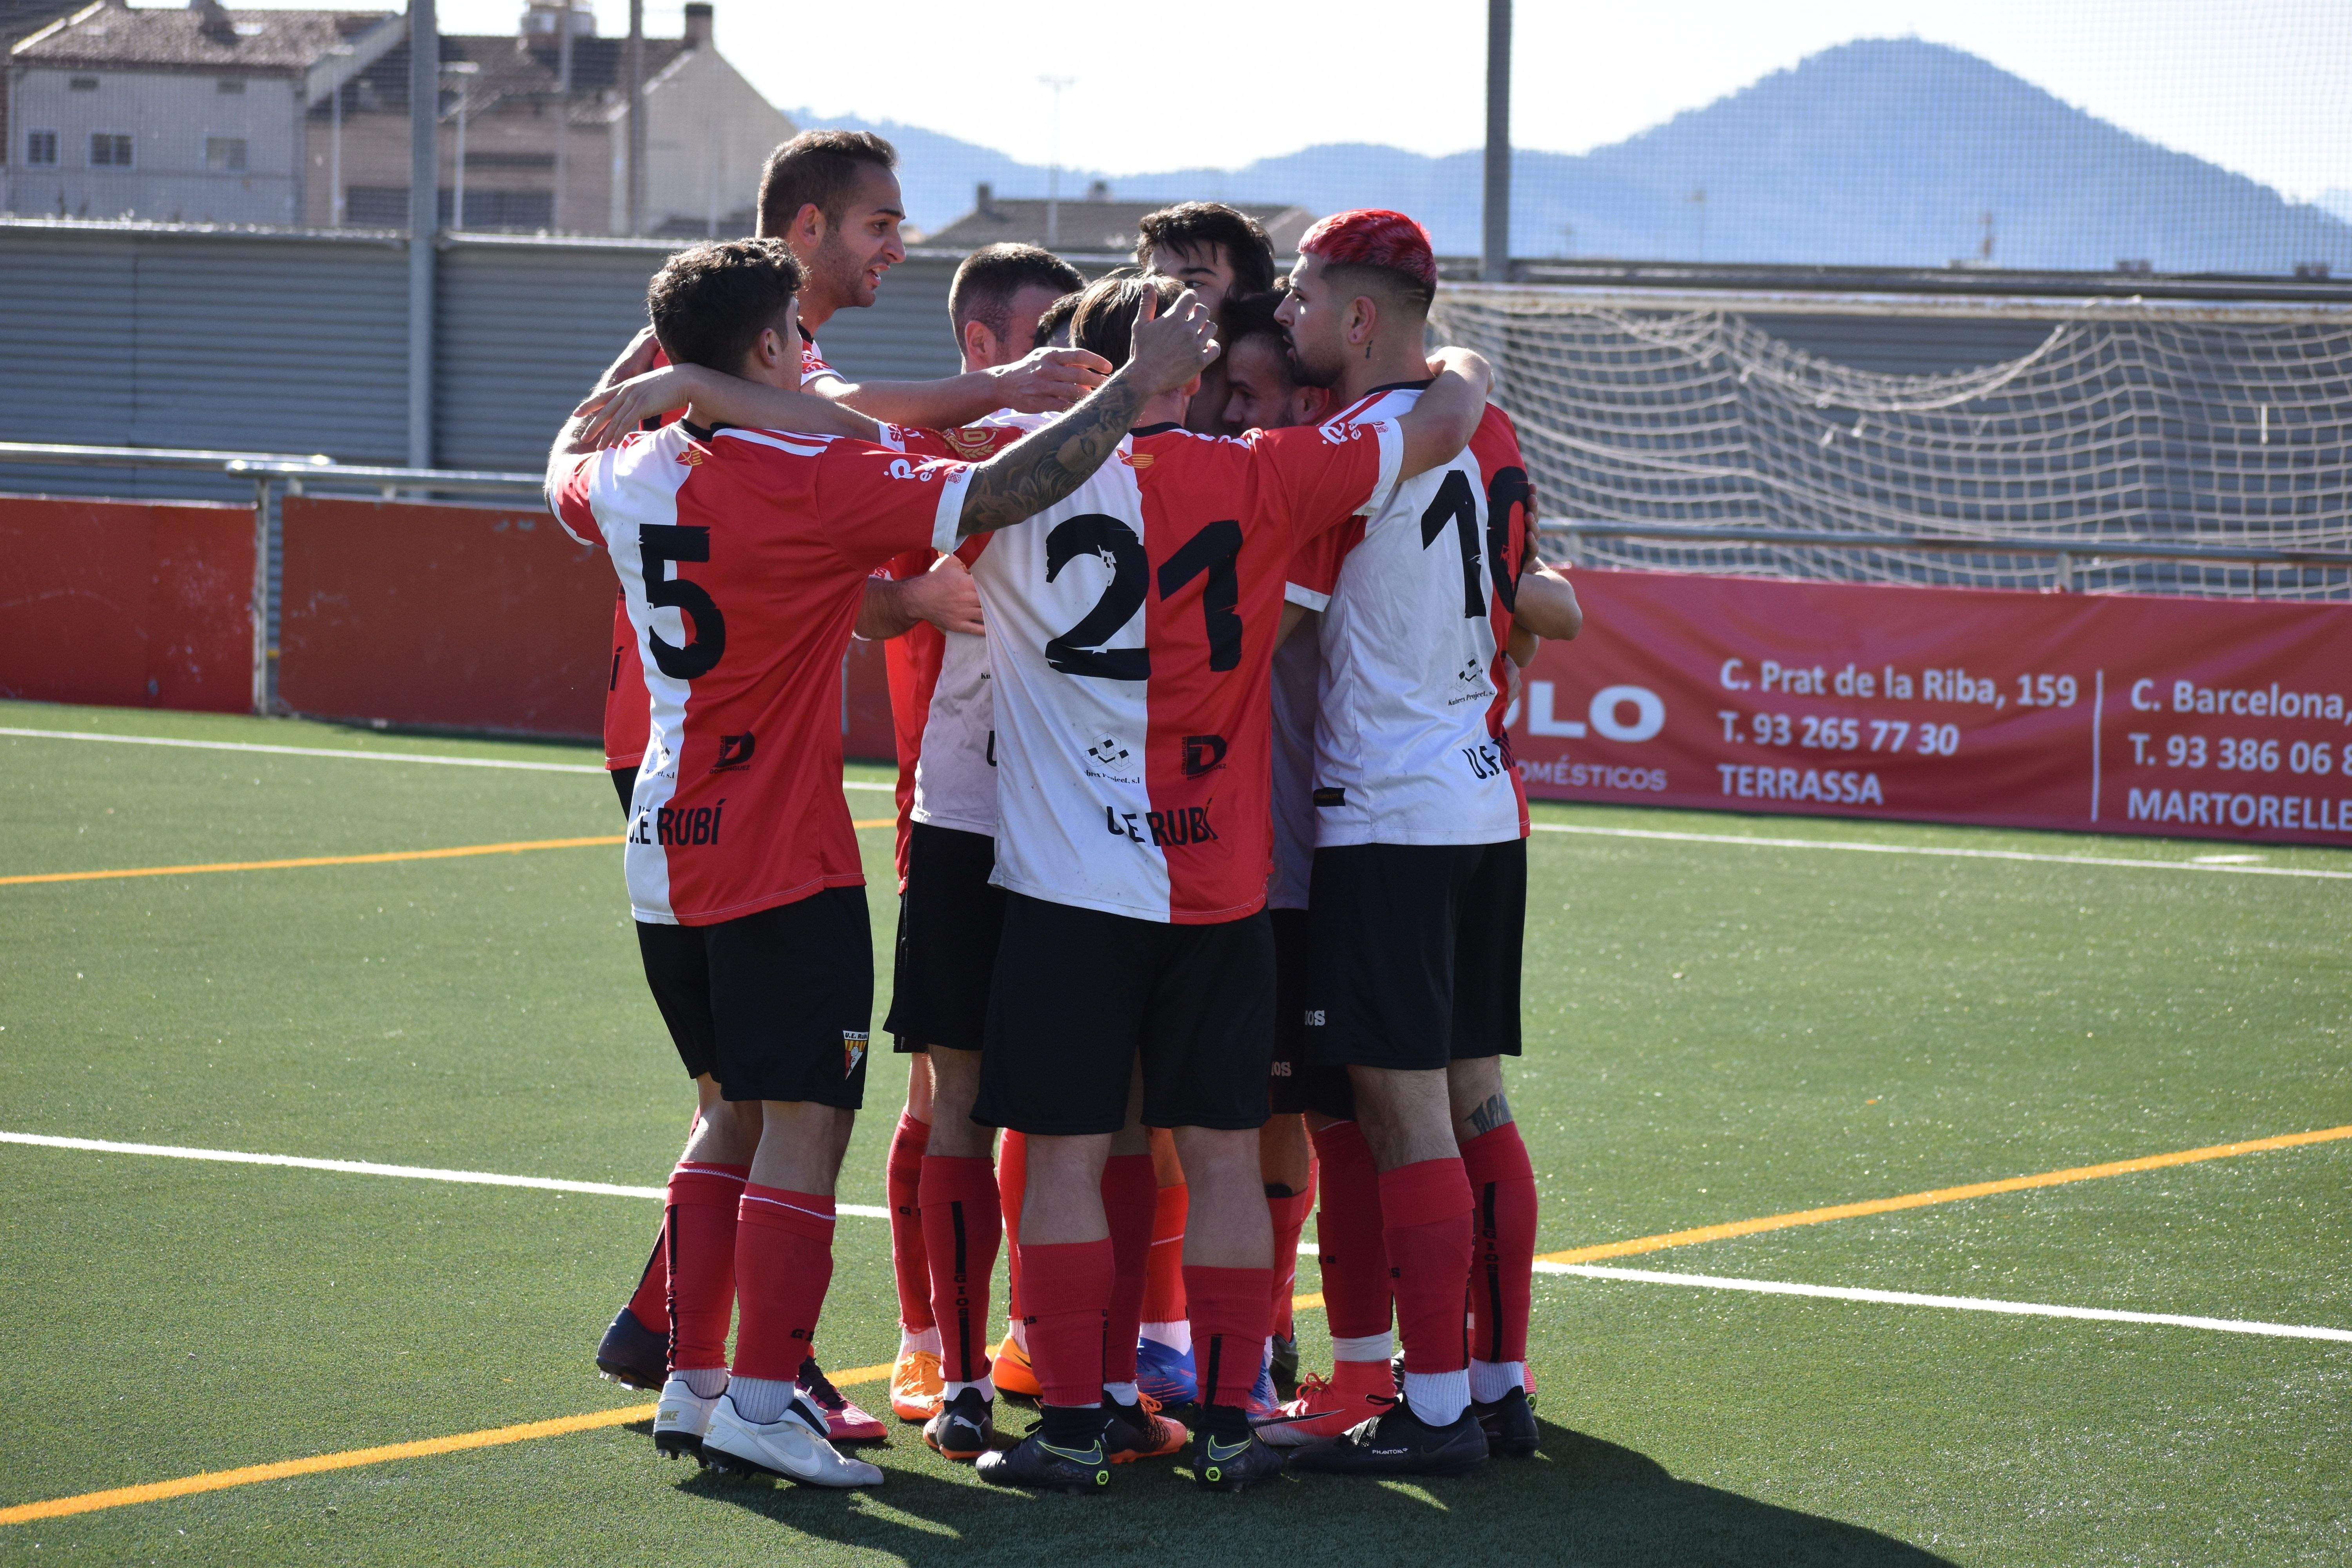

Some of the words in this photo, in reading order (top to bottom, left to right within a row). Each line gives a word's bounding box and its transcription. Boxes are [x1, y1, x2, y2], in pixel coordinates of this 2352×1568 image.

[1420, 465, 1529, 619] 10
[639, 524, 726, 680] 5
[1045, 514, 1244, 681] 21
[1720, 659, 1751, 690] C.
[1761, 661, 1825, 696] Prat
[1835, 663, 1875, 698] de
[1885, 666, 1913, 699] la
[1924, 669, 2006, 710] Riba,
[2017, 674, 2077, 707] 159
[2131, 678, 2161, 711] C.
[2173, 680, 2352, 726] Barcelona,
[1719, 710, 1745, 743] T.
[1753, 713, 1791, 746] 93
[1801, 716, 1859, 750] 265
[1870, 720, 1909, 752] 77
[1918, 723, 1959, 756] 30
[2127, 733, 2156, 765] T.
[2167, 735, 2207, 768] 93
[2217, 737, 2280, 772] 386
[2290, 740, 2332, 775] 06
[1516, 753, 1667, 791] OMÉSTICOS
[1718, 763, 1883, 806] TERRASSA
[657, 798, 727, 846] RUBÍ
